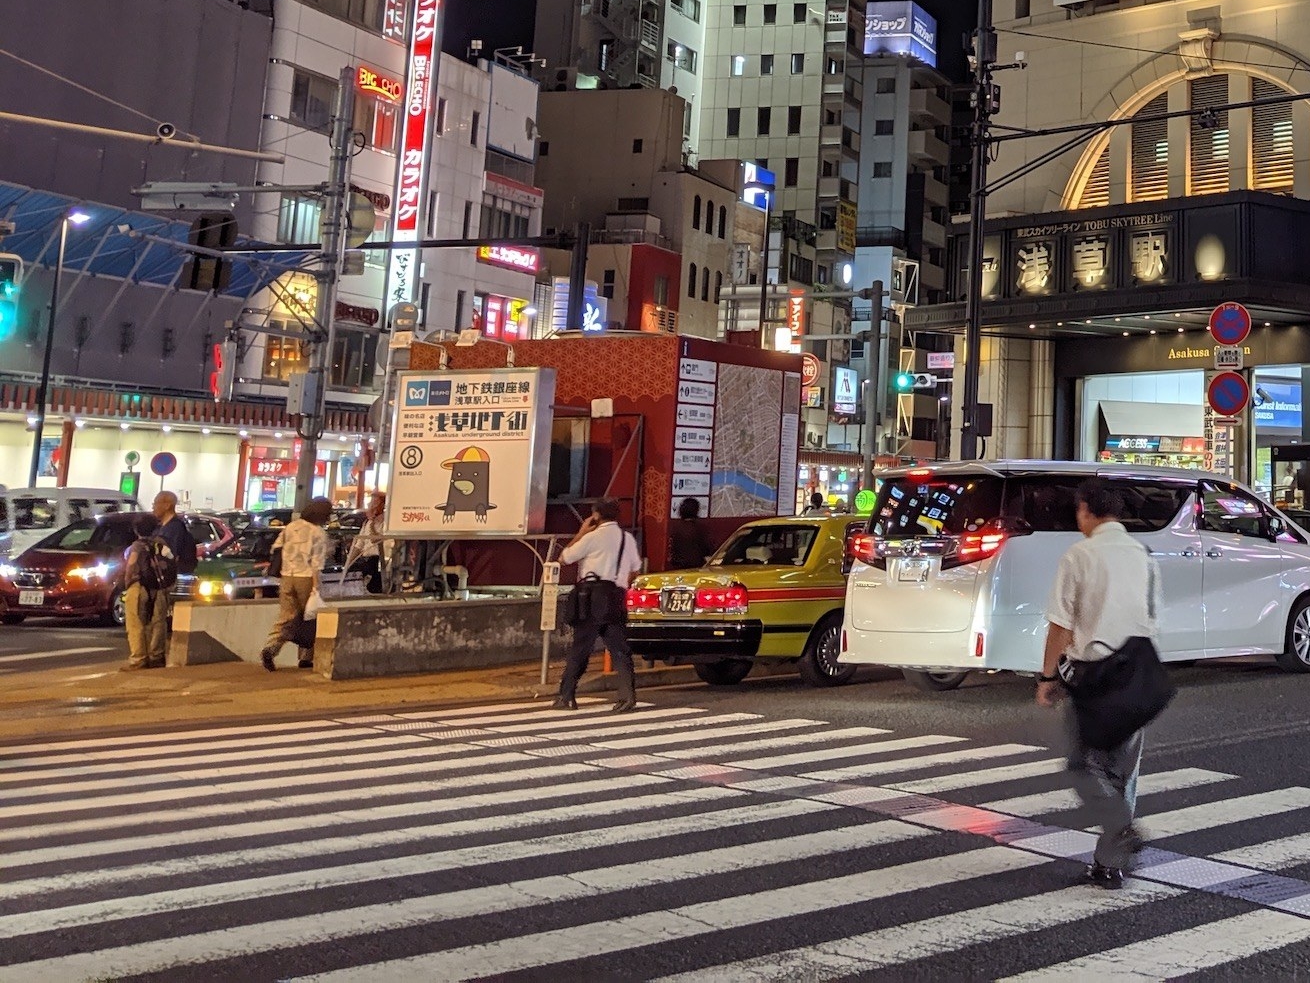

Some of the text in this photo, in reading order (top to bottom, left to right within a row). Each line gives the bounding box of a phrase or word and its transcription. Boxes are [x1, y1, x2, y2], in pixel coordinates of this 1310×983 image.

[409, 55, 427, 116] BIG ECHO
[398, 149, 422, 220] カラオケ
[1017, 213, 1174, 238] 東武スカイツリーライン TOBU SKYTREE Line
[1016, 230, 1167, 289] 浅草駅
[1168, 347, 1210, 359] Asakusa
[455, 381, 530, 395] 地下鉄銀座線
[455, 395, 500, 405] 浅草駅入口
[1118, 438, 1148, 448] ACCESS
[257, 462, 283, 472] カラオケ
